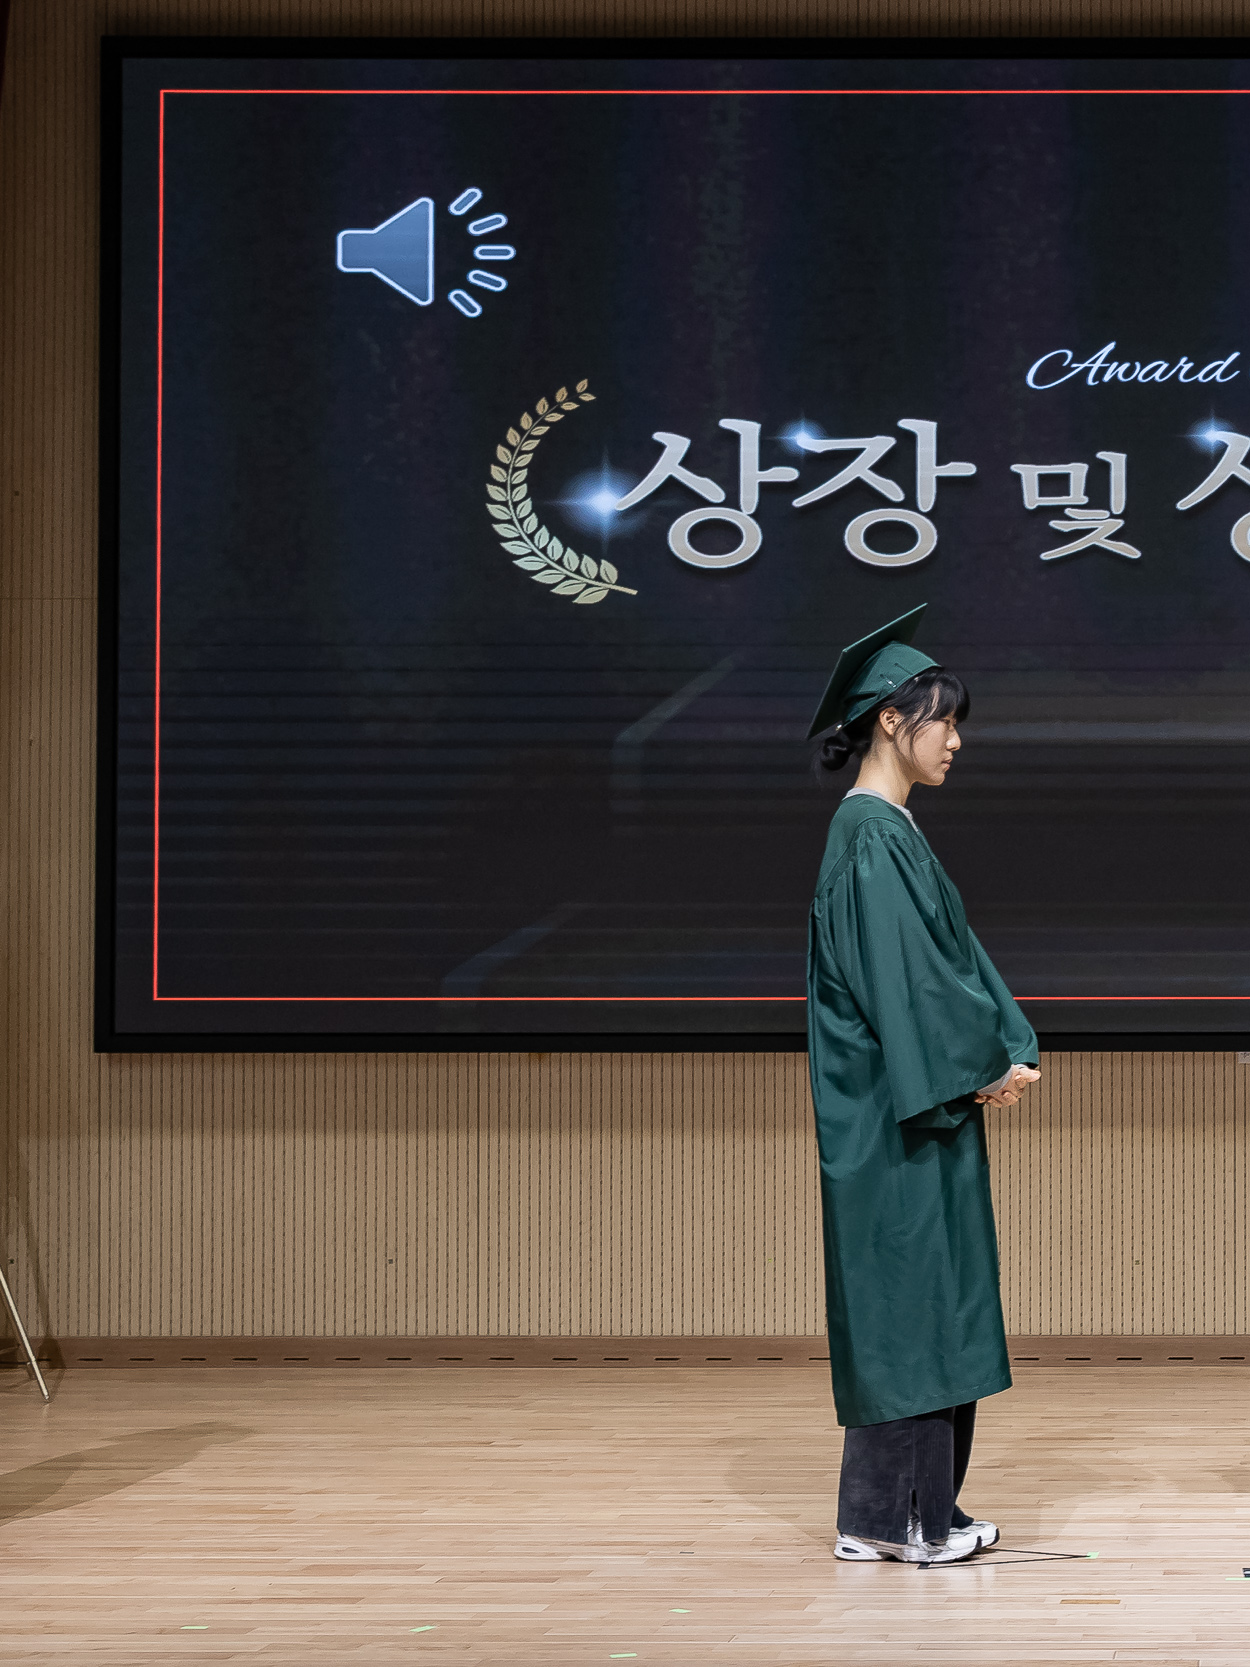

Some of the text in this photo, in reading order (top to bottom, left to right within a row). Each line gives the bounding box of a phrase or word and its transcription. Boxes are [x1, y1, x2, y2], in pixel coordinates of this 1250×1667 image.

[1026, 341, 1240, 389] Award
[614, 418, 977, 568] 상장
[1010, 451, 1141, 560] 및
